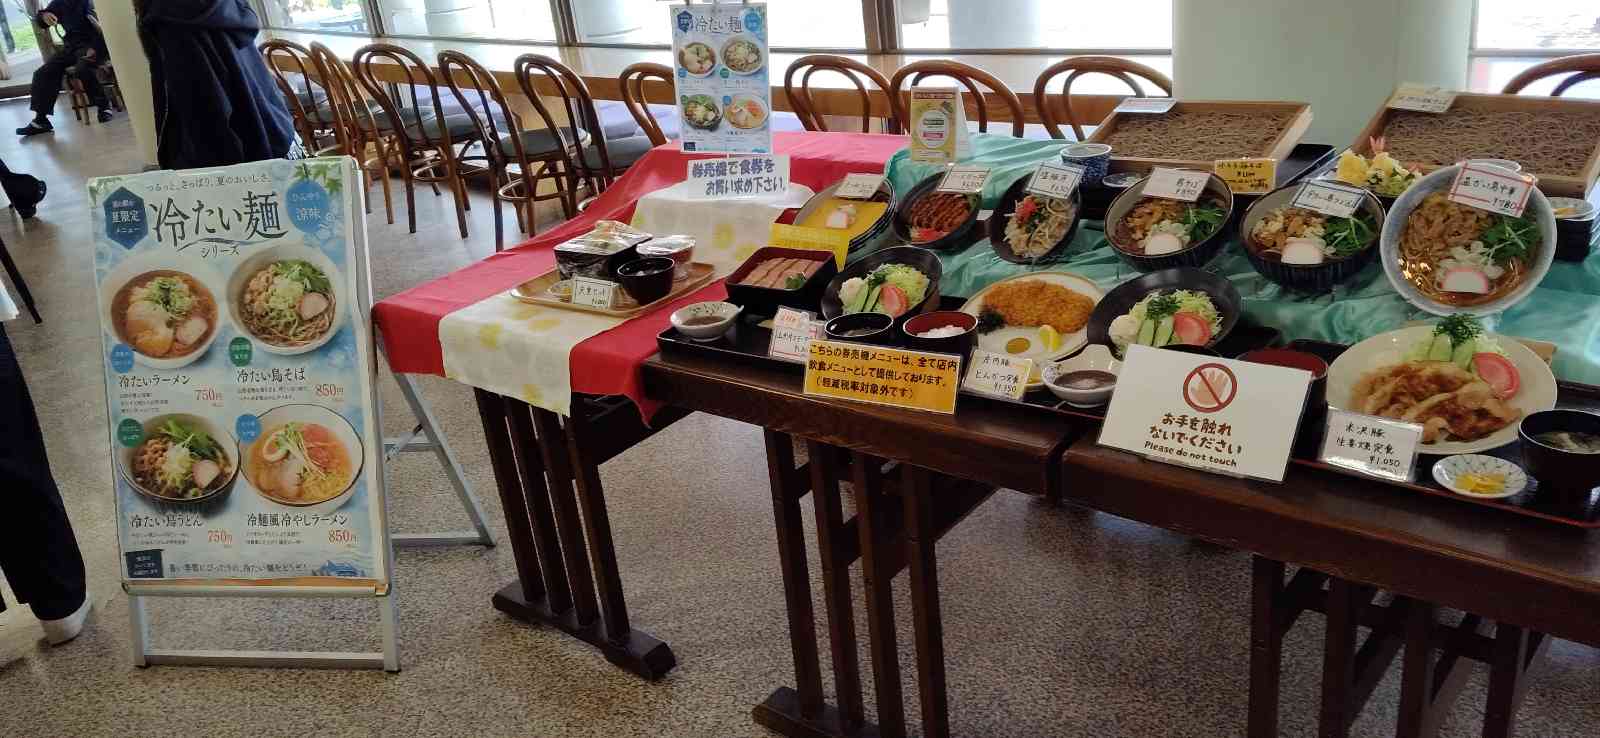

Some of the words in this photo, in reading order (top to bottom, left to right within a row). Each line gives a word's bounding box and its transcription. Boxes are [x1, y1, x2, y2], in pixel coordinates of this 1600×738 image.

[695, 15, 743, 33] 冷たい麺
[692, 158, 776, 179] 券売機で食券を
[705, 177, 786, 196] お買い求め下さい。
[149, 190, 288, 247] 冷たい麺
[200, 244, 241, 259] シリーズ
[810, 343, 958, 374] こちらの券売機メニューは、全て店内
[119, 375, 192, 389] 冷たいラーメン
[237, 367, 306, 384] 冷たい鳥そば
[808, 360, 947, 388] 飲食メニューとして提供しております。
[193, 386, 225, 401] 750円
[313, 384, 345, 398] 850円
[1161, 412, 1231, 437] お手を触れ
[1148, 425, 1243, 455] ないでください
[1144, 440, 1175, 456] Please
[1176, 446, 1189, 458] do
[1190, 451, 1207, 462] not
[1209, 453, 1237, 468] touch
[247, 512, 348, 528] 冷麺風冷やしラーメン
[328, 529, 359, 545] 850円
